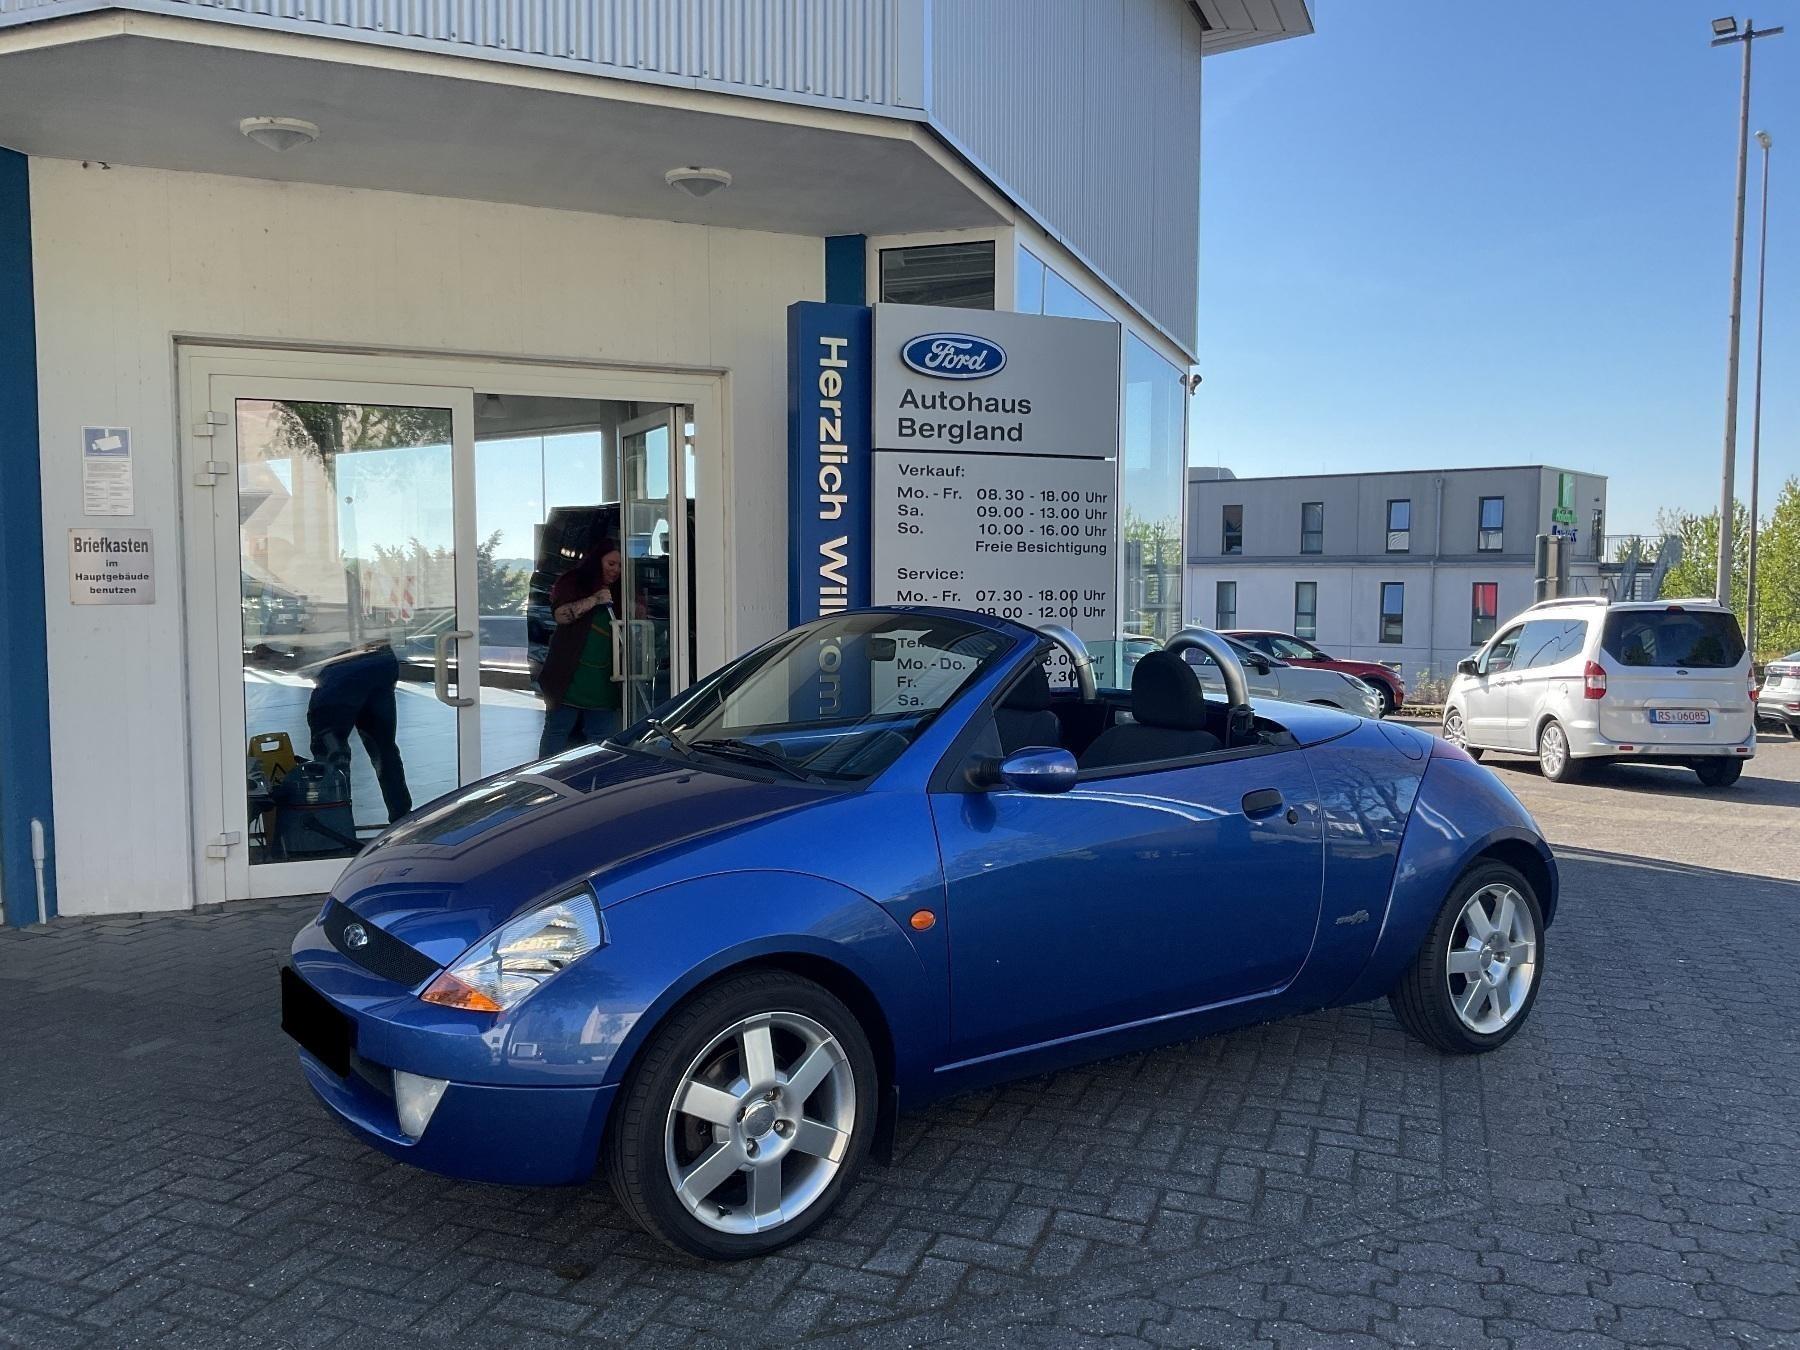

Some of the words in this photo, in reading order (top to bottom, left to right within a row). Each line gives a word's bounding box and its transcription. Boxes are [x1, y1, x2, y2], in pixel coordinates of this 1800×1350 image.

[925, 340, 987, 370] Ford
[898, 388, 1032, 415] Autohaus
[818, 336, 848, 520] Herzlich
[898, 417, 1023, 444] Bergland
[898, 463, 966, 478] Verkauf:
[897, 486, 929, 500] Mo.
[943, 487, 963, 500] Fr.
[976, 488, 1025, 502] 08.30
[1040, 490, 1080, 503] 18.00
[1085, 491, 1108, 504] Uhr
[897, 504, 924, 517] Sa.
[976, 506, 1024, 519] 09.00
[1040, 507, 1080, 520] 13.00
[1085, 508, 1108, 520] Uhr
[897, 521, 924, 534] So.
[978, 523, 1024, 536] 10.00
[1040, 524, 1080, 537] 16.00
[1085, 525, 1107, 537] Uhr
[73, 537, 149, 553] Briefkasten
[975, 540, 1013, 553] Freie
[1017, 541, 1107, 556] Besichtigung
[105, 559, 119, 568] im
[75, 572, 150, 584] Hauptgebäude
[897, 567, 964, 580] Service:
[89, 586, 137, 594] benutzen
[897, 590, 929, 602] Mo.
[942, 590, 962, 602] Fr.
[975, 590, 1023, 602] 07.30
[1038, 590, 1078, 602] 18.00
[1083, 589, 1106, 601] Uhr
[976, 607, 1023, 618] 0800
[1038, 606, 1078, 618] 12.00
[1083, 606, 1106, 618] Uhr
[897, 657, 927, 670] Mo.
[939, 657, 967, 671] Do.
[897, 675, 918, 688] Fr.
[897, 694, 924, 706] Sa.
